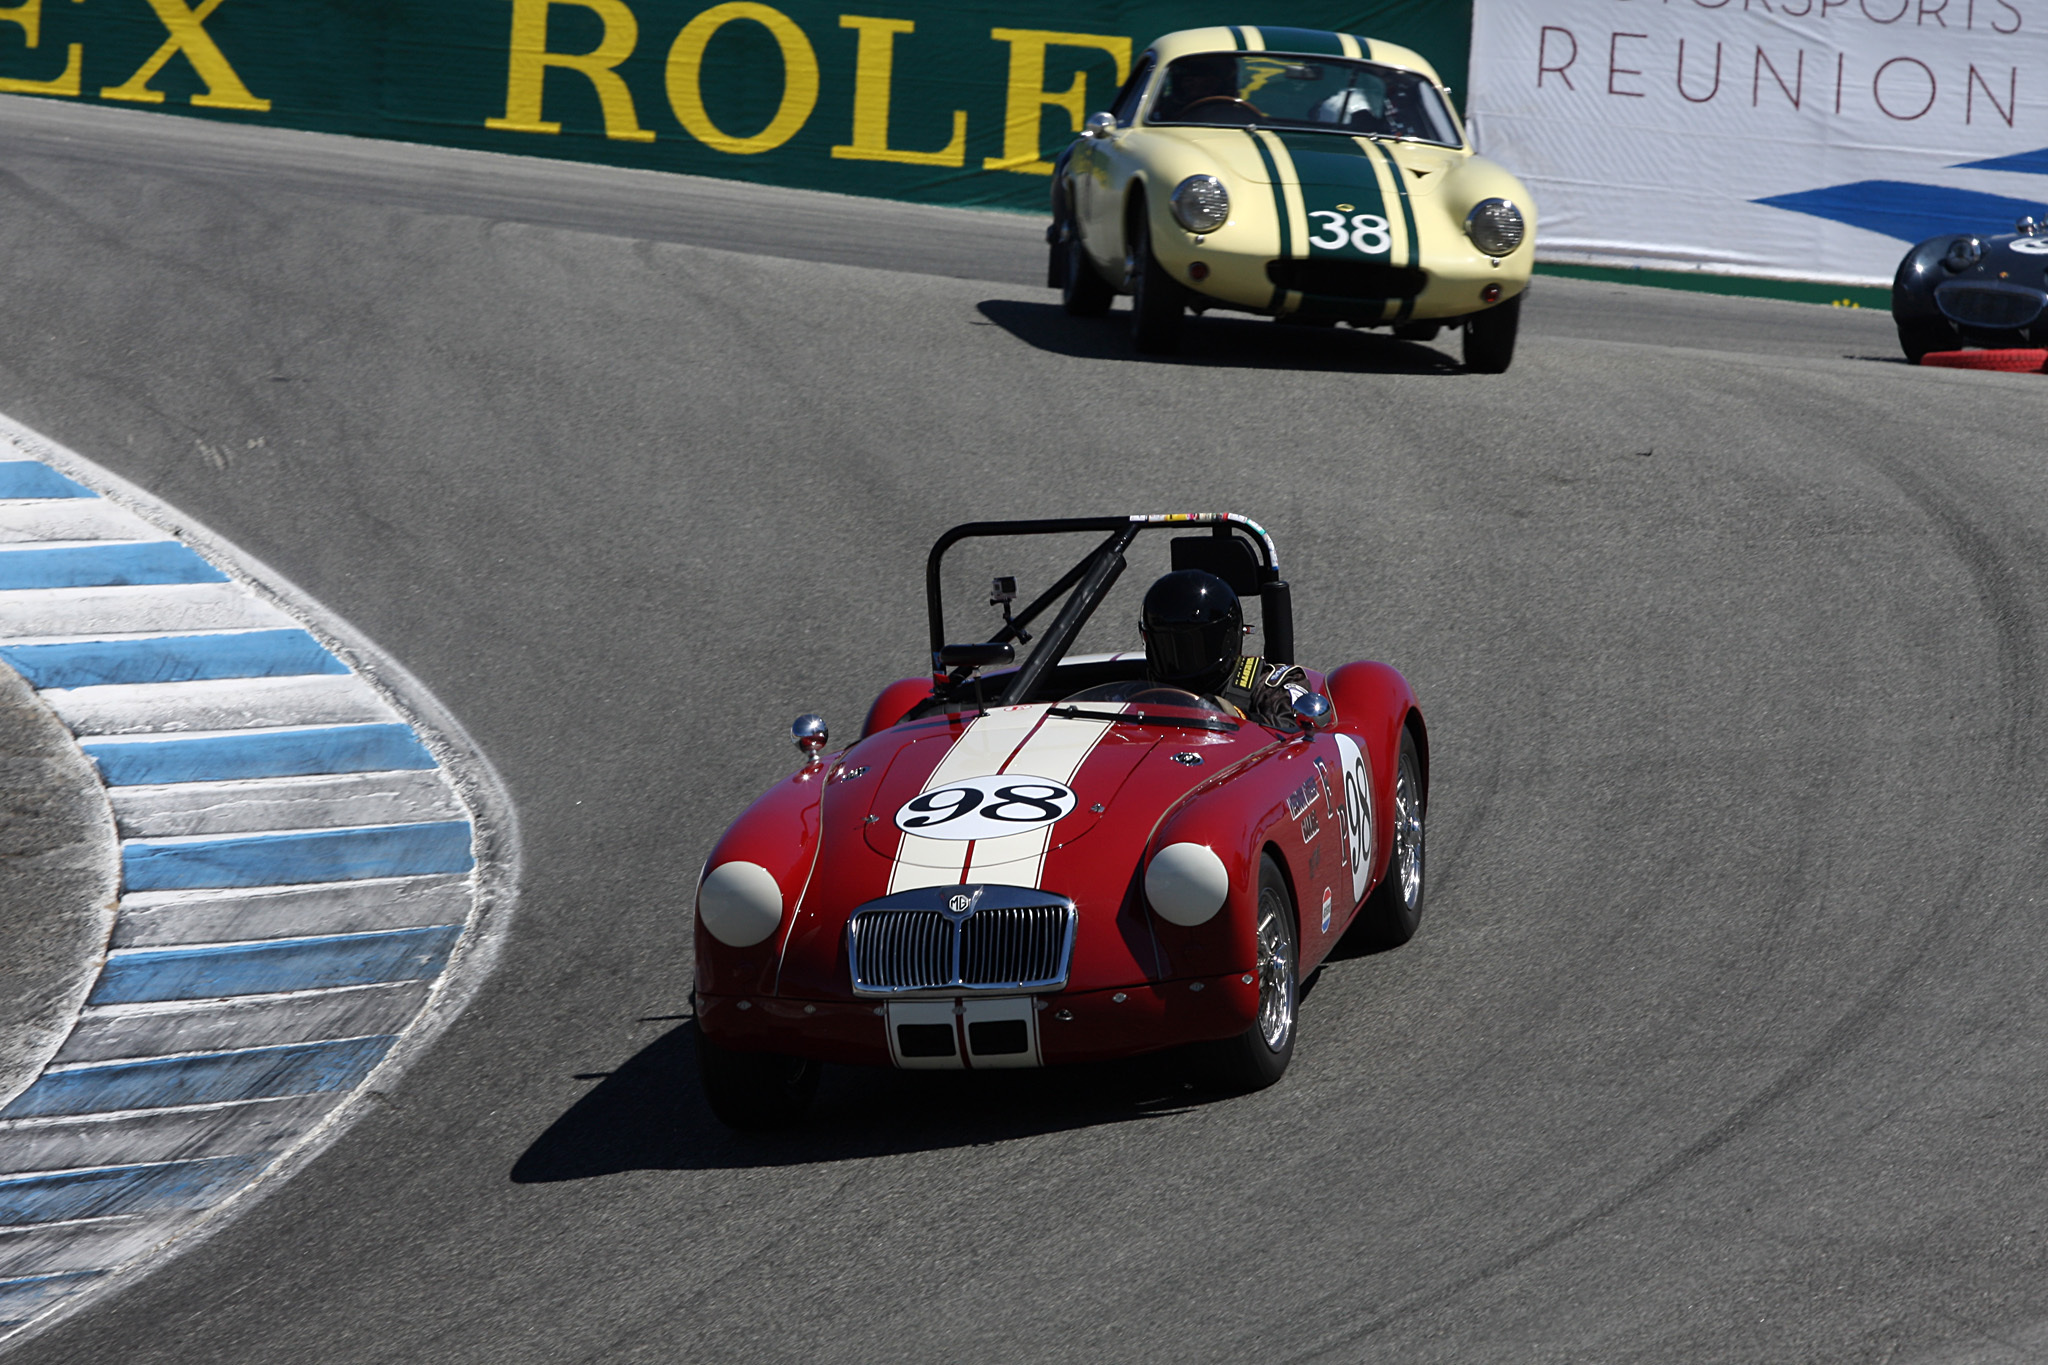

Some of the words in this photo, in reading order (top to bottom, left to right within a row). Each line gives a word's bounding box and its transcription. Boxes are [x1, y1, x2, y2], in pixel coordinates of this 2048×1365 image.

[1537, 25, 2018, 128] REUNION
[1308, 210, 1391, 254] 38
[903, 784, 1068, 828] 98
[1345, 757, 1371, 875] 98
[950, 895, 968, 911] MG
